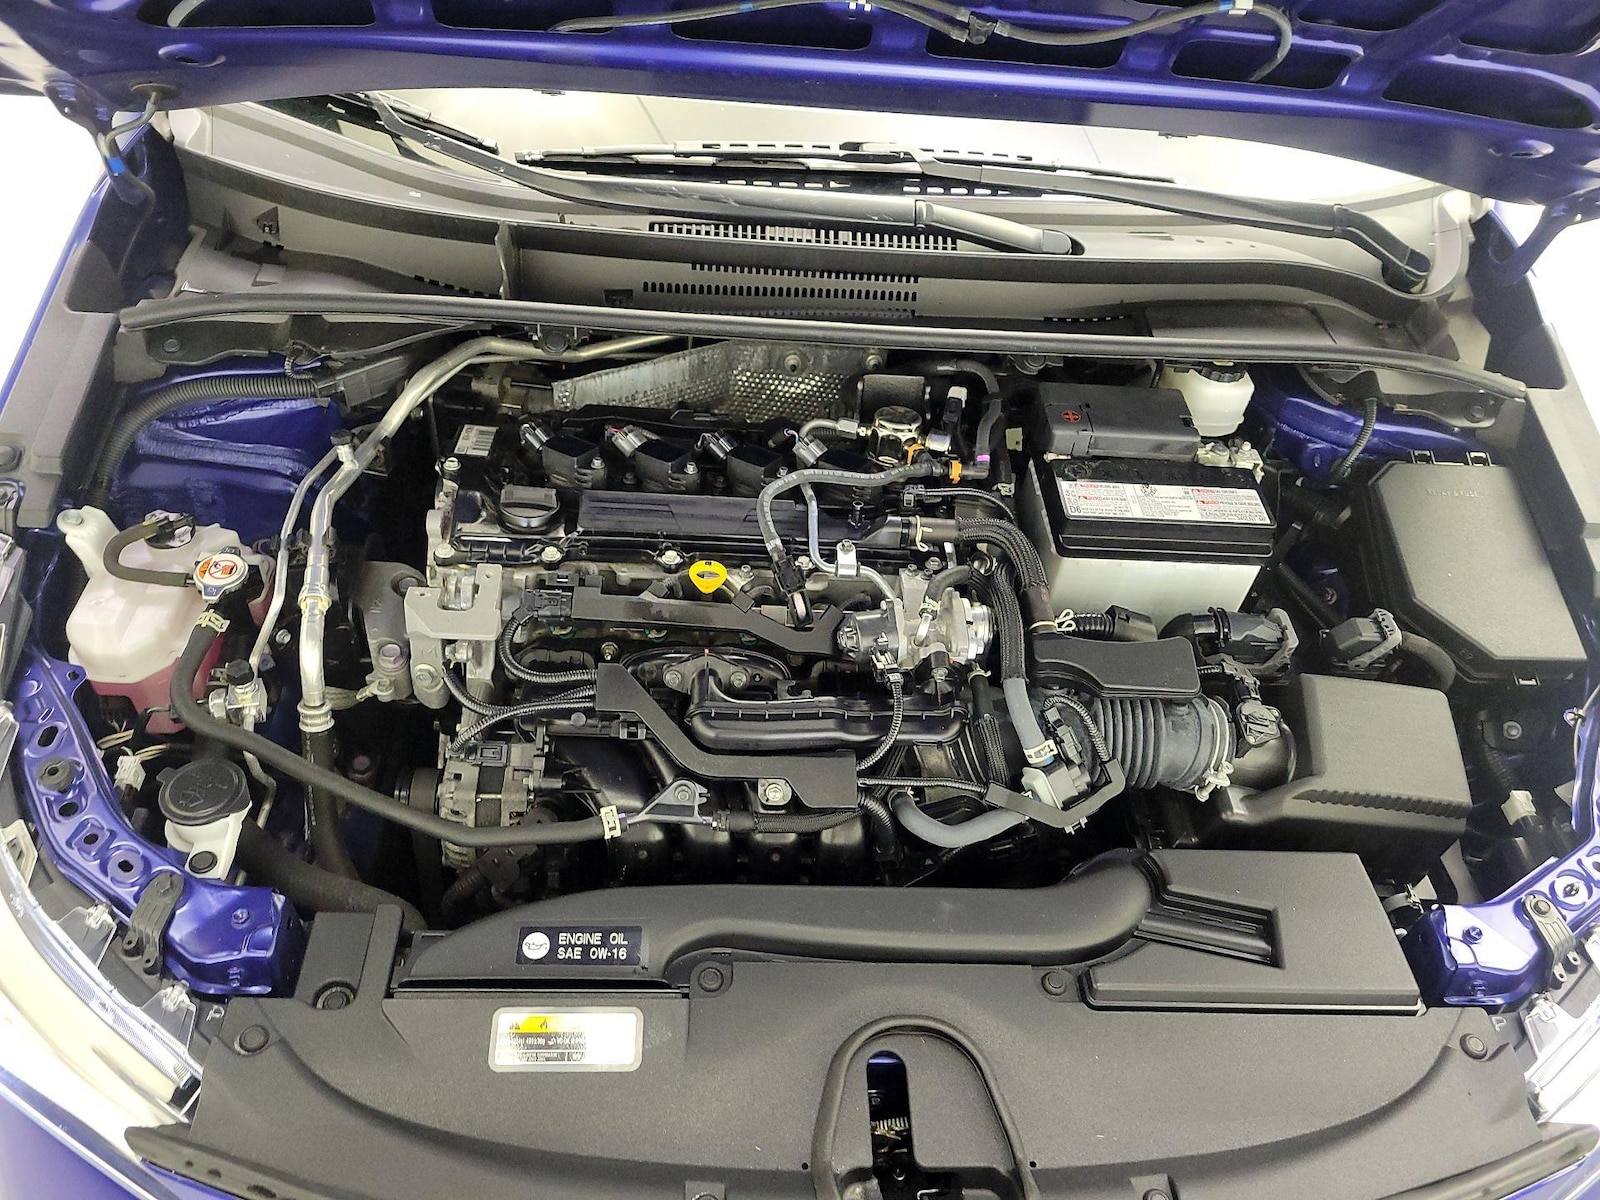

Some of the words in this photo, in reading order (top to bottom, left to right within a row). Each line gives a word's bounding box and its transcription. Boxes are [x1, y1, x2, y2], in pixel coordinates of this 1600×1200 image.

[558, 932, 603, 945] ENGINE
[609, 932, 628, 945] OIL
[557, 946, 583, 960] SAE
[589, 946, 628, 960] 0W-16
